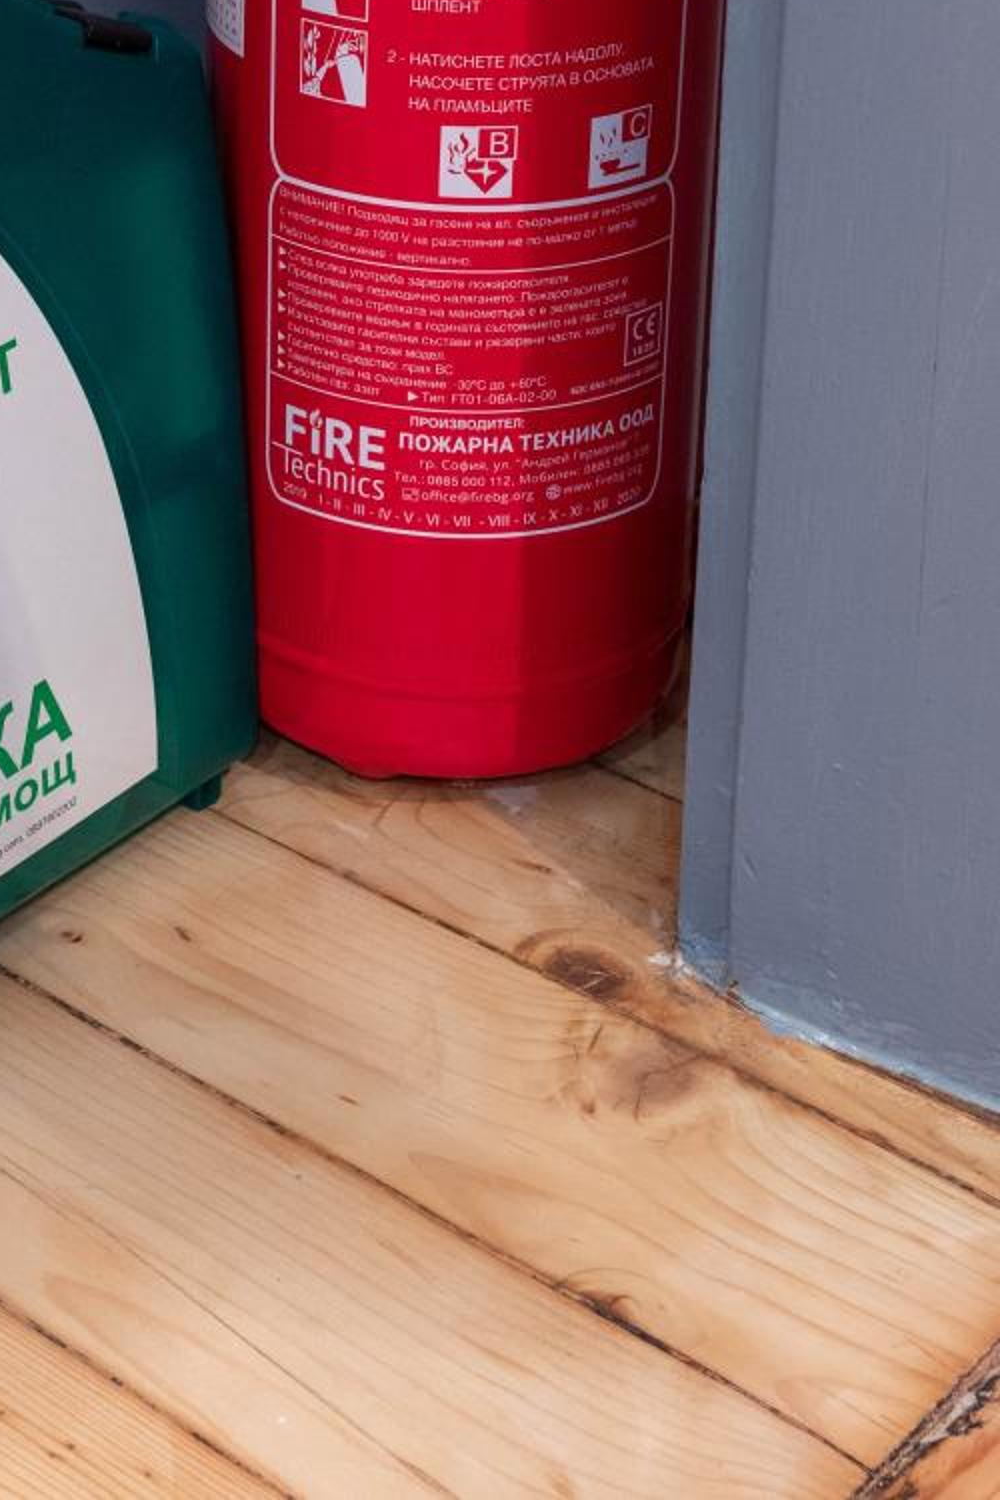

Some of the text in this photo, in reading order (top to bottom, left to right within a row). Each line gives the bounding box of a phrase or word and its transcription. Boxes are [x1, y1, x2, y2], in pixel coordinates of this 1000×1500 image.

[386, 49, 397, 64] 2
[409, 52, 505, 69] НАТИСНЕТЕ
[508, 51, 561, 69] ЛОСТА
[408, 74, 495, 91] НАСОЧЕТЕ
[499, 74, 567, 91] СТРУЯТА
[583, 56, 655, 83] ОСНОВАТА
[408, 97, 533, 115] НА ПЛАМЪЦИТЕ
[397, 431, 514, 455] ПОЖАРНА
[518, 419, 615, 452] ТЕХНИКА
[619, 403, 655, 433] ООД
[272, 441, 386, 501] Technics
